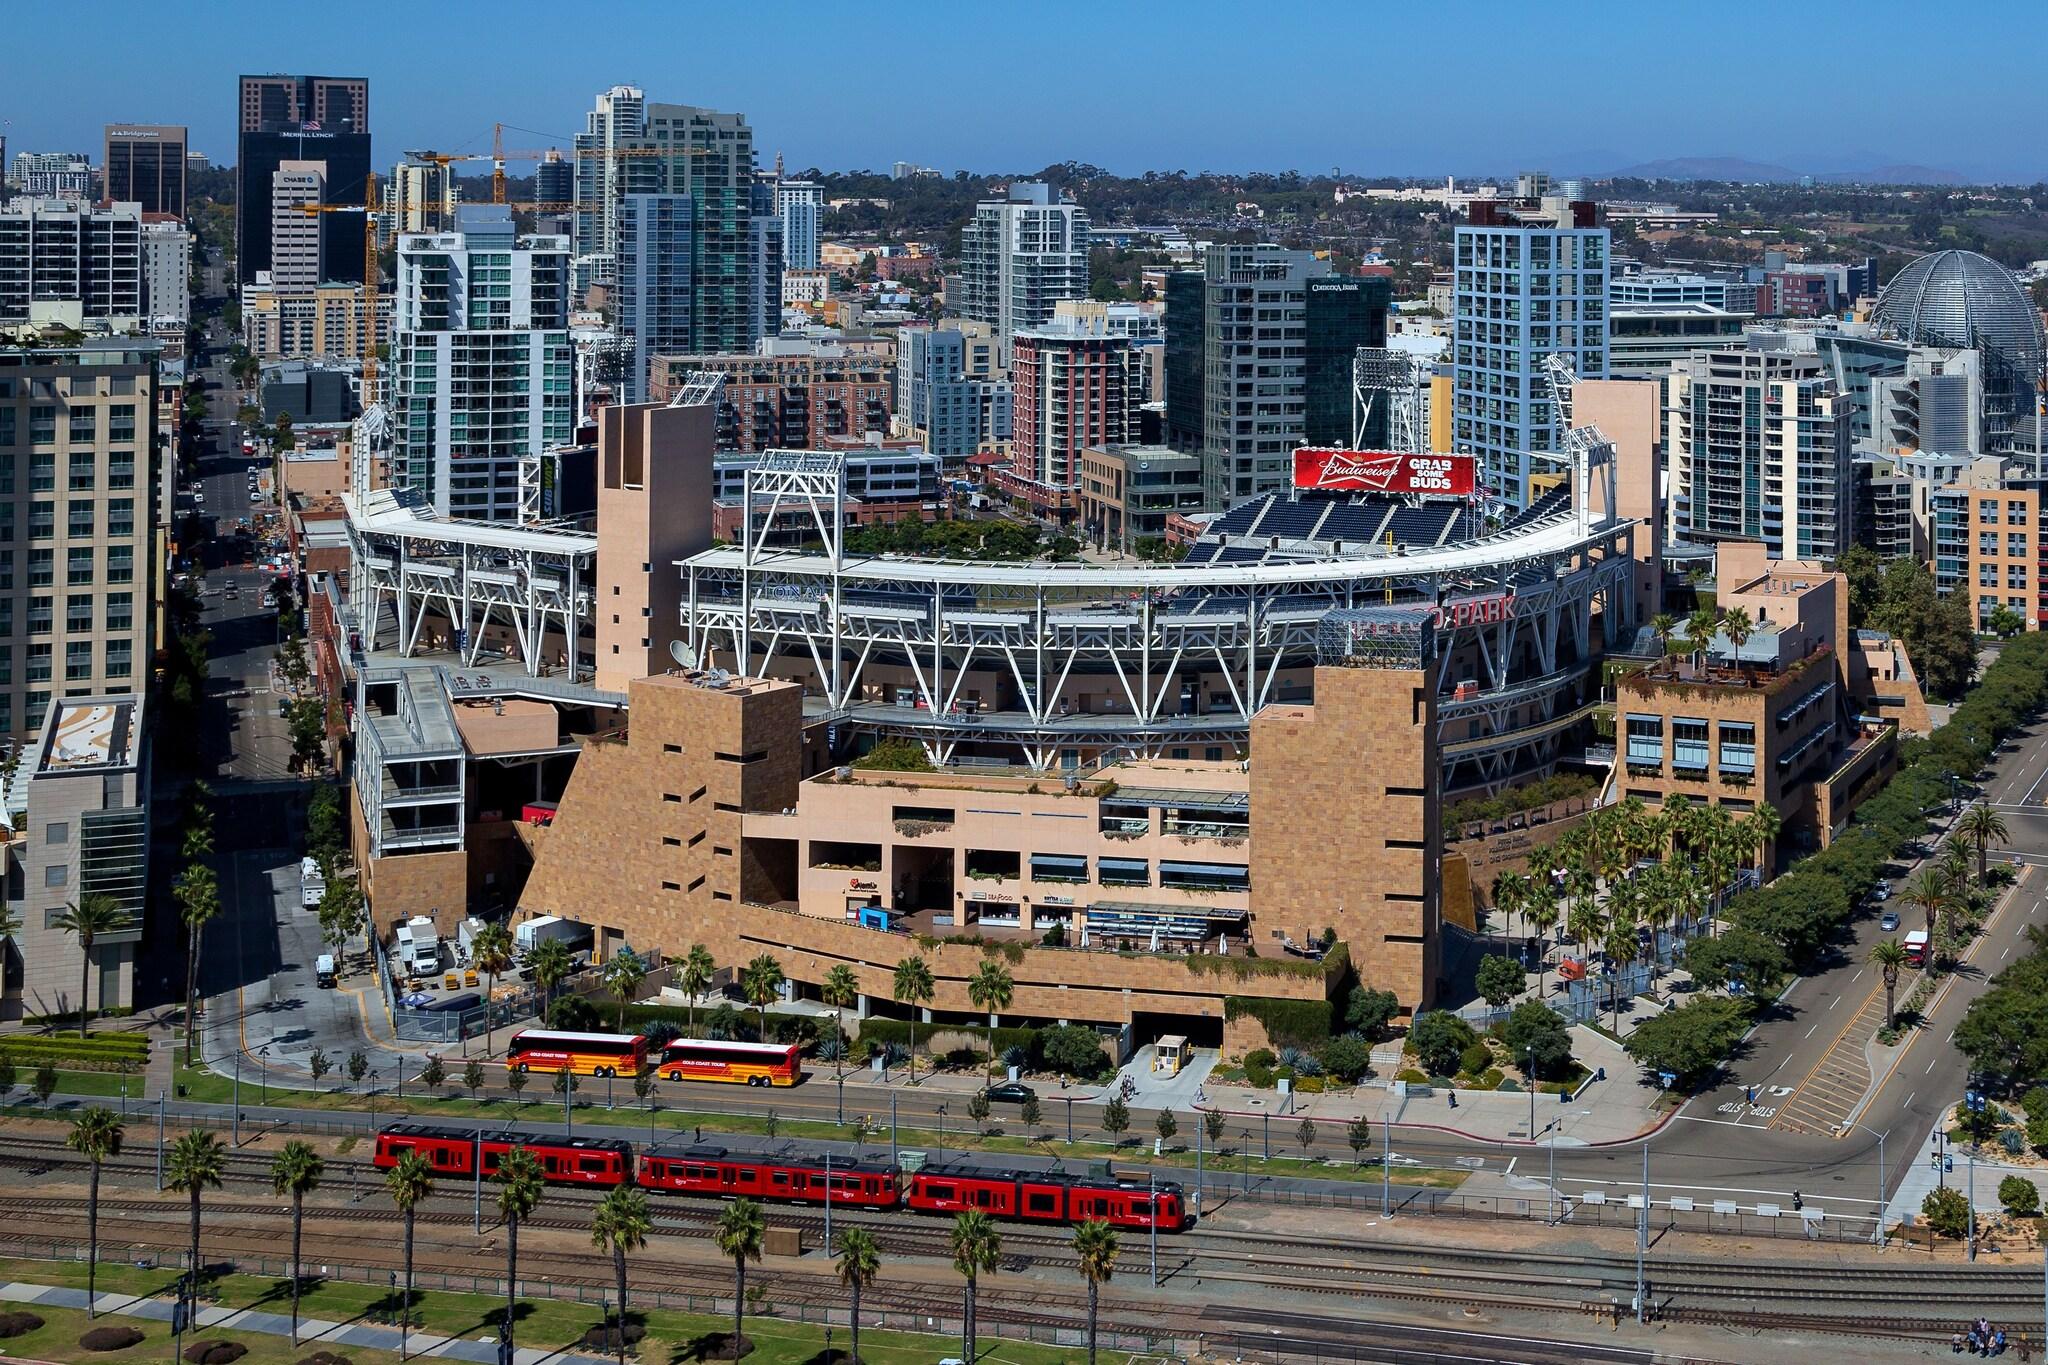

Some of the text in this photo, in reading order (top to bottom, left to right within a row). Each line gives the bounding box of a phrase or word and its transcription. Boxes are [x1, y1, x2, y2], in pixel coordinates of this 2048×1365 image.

[1319, 460, 1398, 477] Budweiser
[1409, 459, 1452, 471] GRAB
[1417, 470, 1444, 478] SOME
[544, 458, 553, 516] SUBWAY
[1409, 477, 1452, 489] BUDS
[1455, 597, 1516, 627] PARK
[1718, 1102, 1745, 1113] STOP
[1750, 1106, 1776, 1117] STOP
